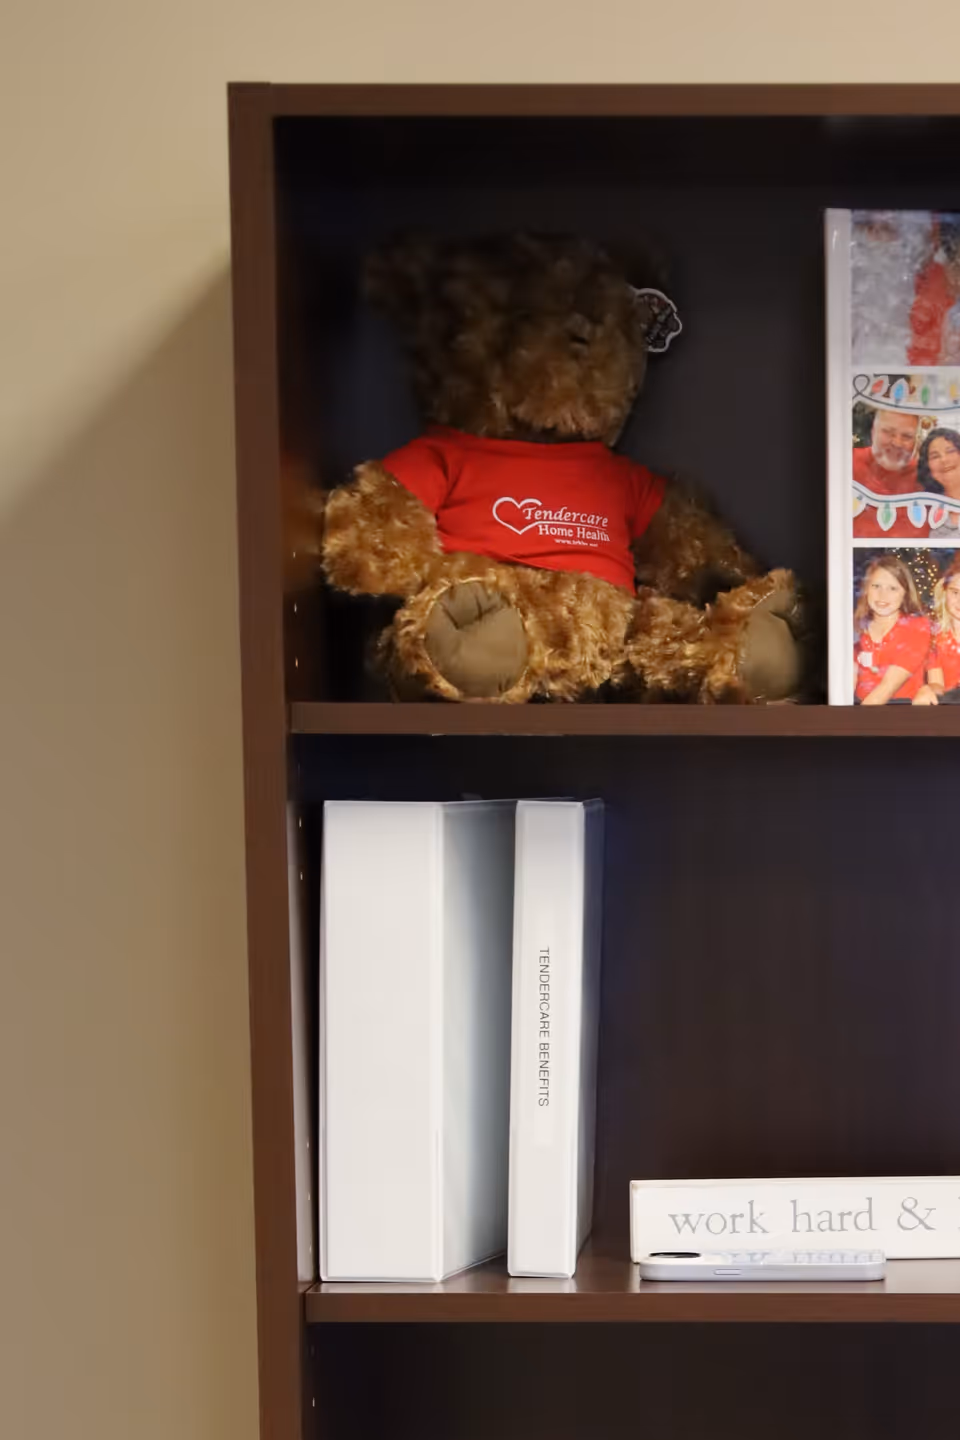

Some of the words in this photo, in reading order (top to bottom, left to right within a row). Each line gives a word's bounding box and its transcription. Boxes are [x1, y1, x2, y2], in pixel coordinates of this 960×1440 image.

[522, 506, 609, 527] Tendercare
[538, 524, 574, 537] Home
[576, 527, 610, 542] Health
[538, 947, 550, 1038] TENDERCARE
[538, 1042, 550, 1107] BENEFITS
[668, 1199, 769, 1235] work
[790, 1197, 878, 1233] hard
[897, 1196, 937, 1231] &
